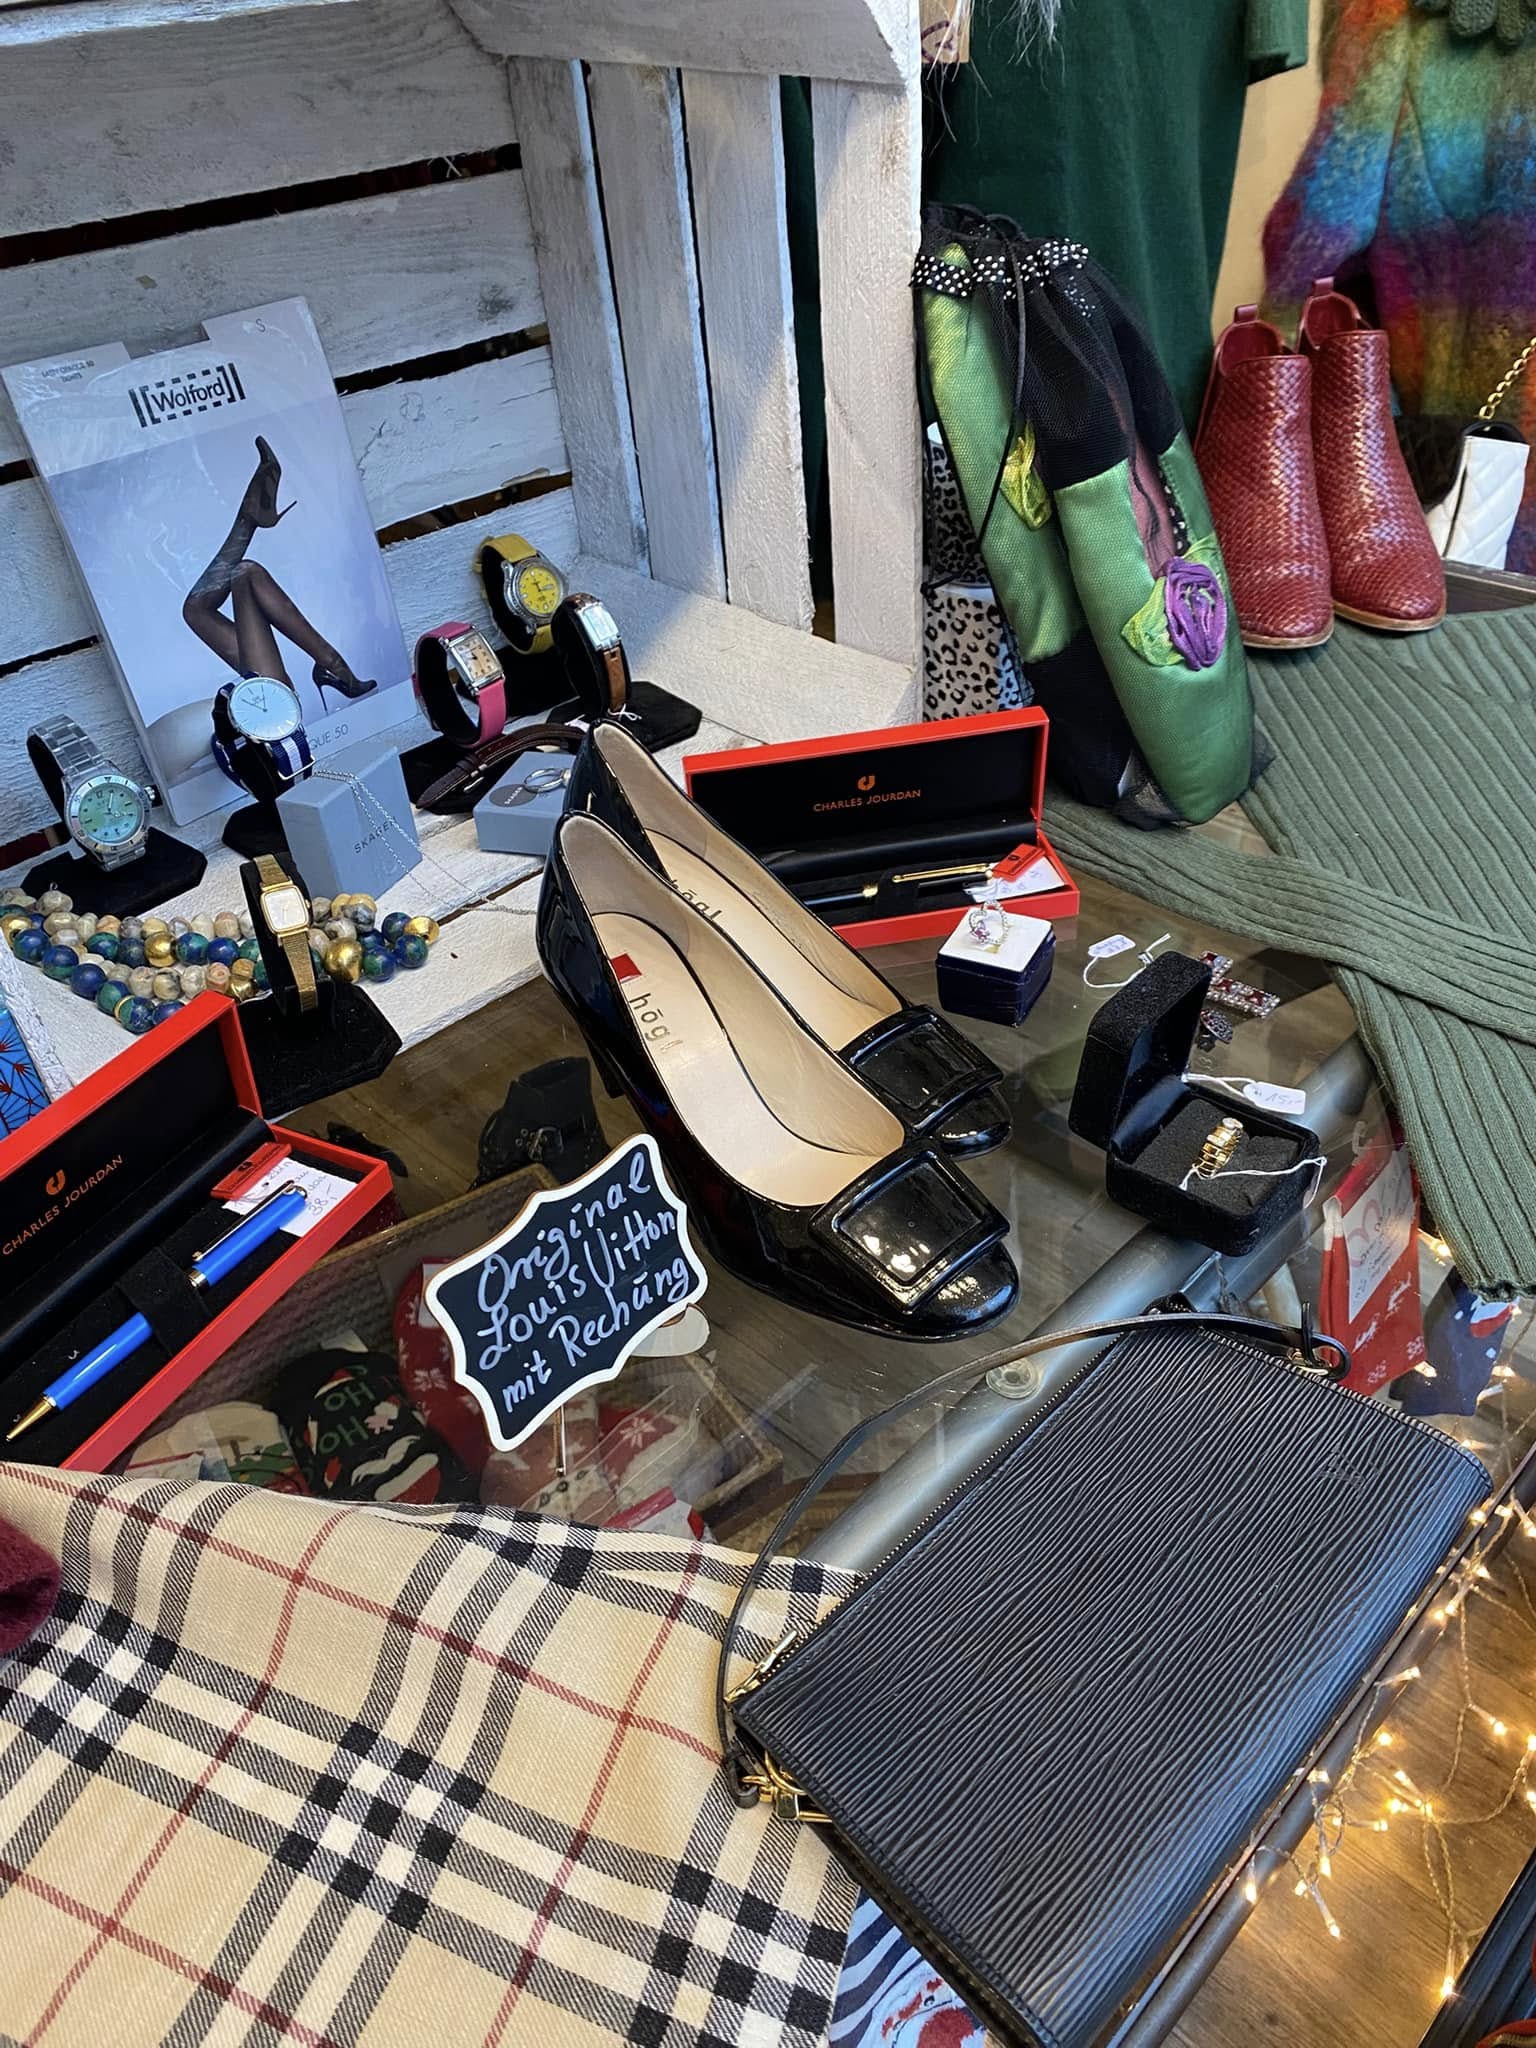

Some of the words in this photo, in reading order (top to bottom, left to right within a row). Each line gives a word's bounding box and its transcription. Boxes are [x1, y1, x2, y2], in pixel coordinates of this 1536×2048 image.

[255, 318, 266, 333] S
[151, 376, 226, 413] Wolford
[309, 730, 331, 750] QUE
[334, 723, 349, 739] 50
[812, 797, 863, 812] CHARLES
[865, 789, 921, 805] JOURDAN
[2, 1205, 60, 1255] CHARLES
[64, 1154, 123, 1208] JOURDAN
[477, 1151, 651, 1313] Original
[477, 1263, 587, 1371] Louis
[583, 1209, 677, 1290] Vitton
[502, 1350, 552, 1413] mit
